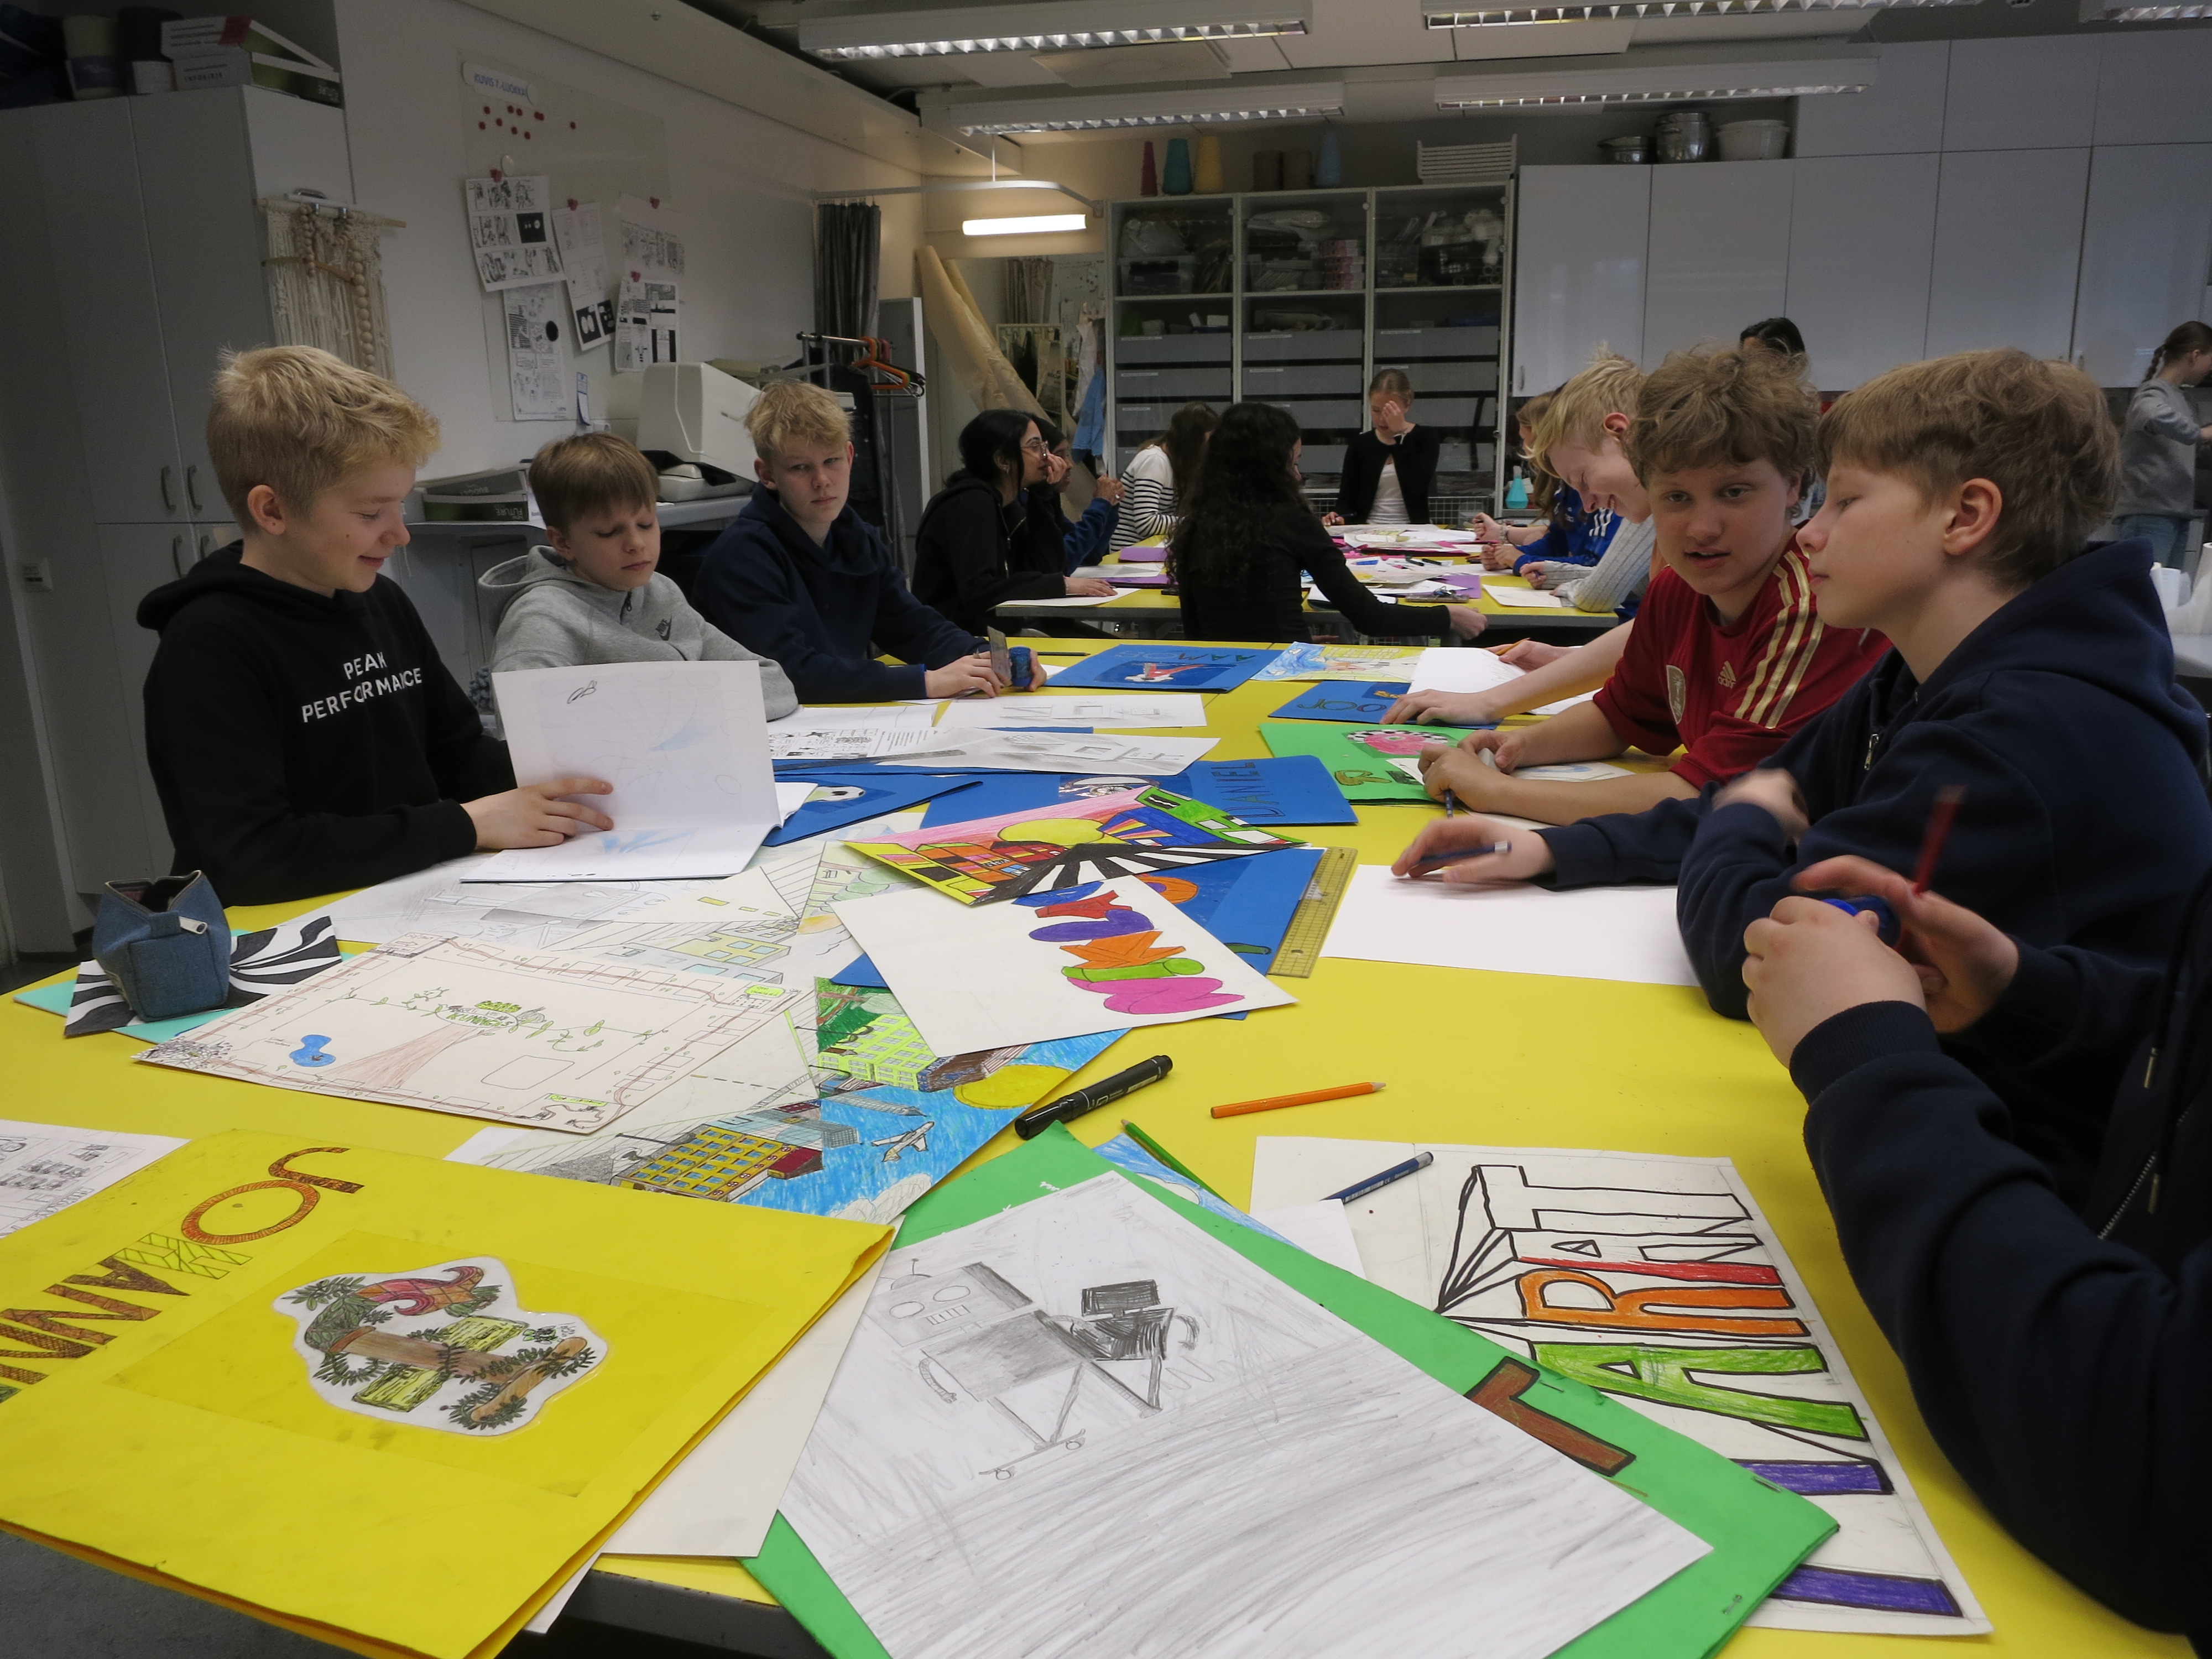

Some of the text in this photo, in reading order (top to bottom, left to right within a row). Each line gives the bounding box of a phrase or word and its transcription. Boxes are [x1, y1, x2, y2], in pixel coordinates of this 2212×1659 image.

[343, 651, 388, 680] PEAK
[1211, 762, 1286, 818] DANIEL
[0, 1146, 365, 1405] JOHANN
